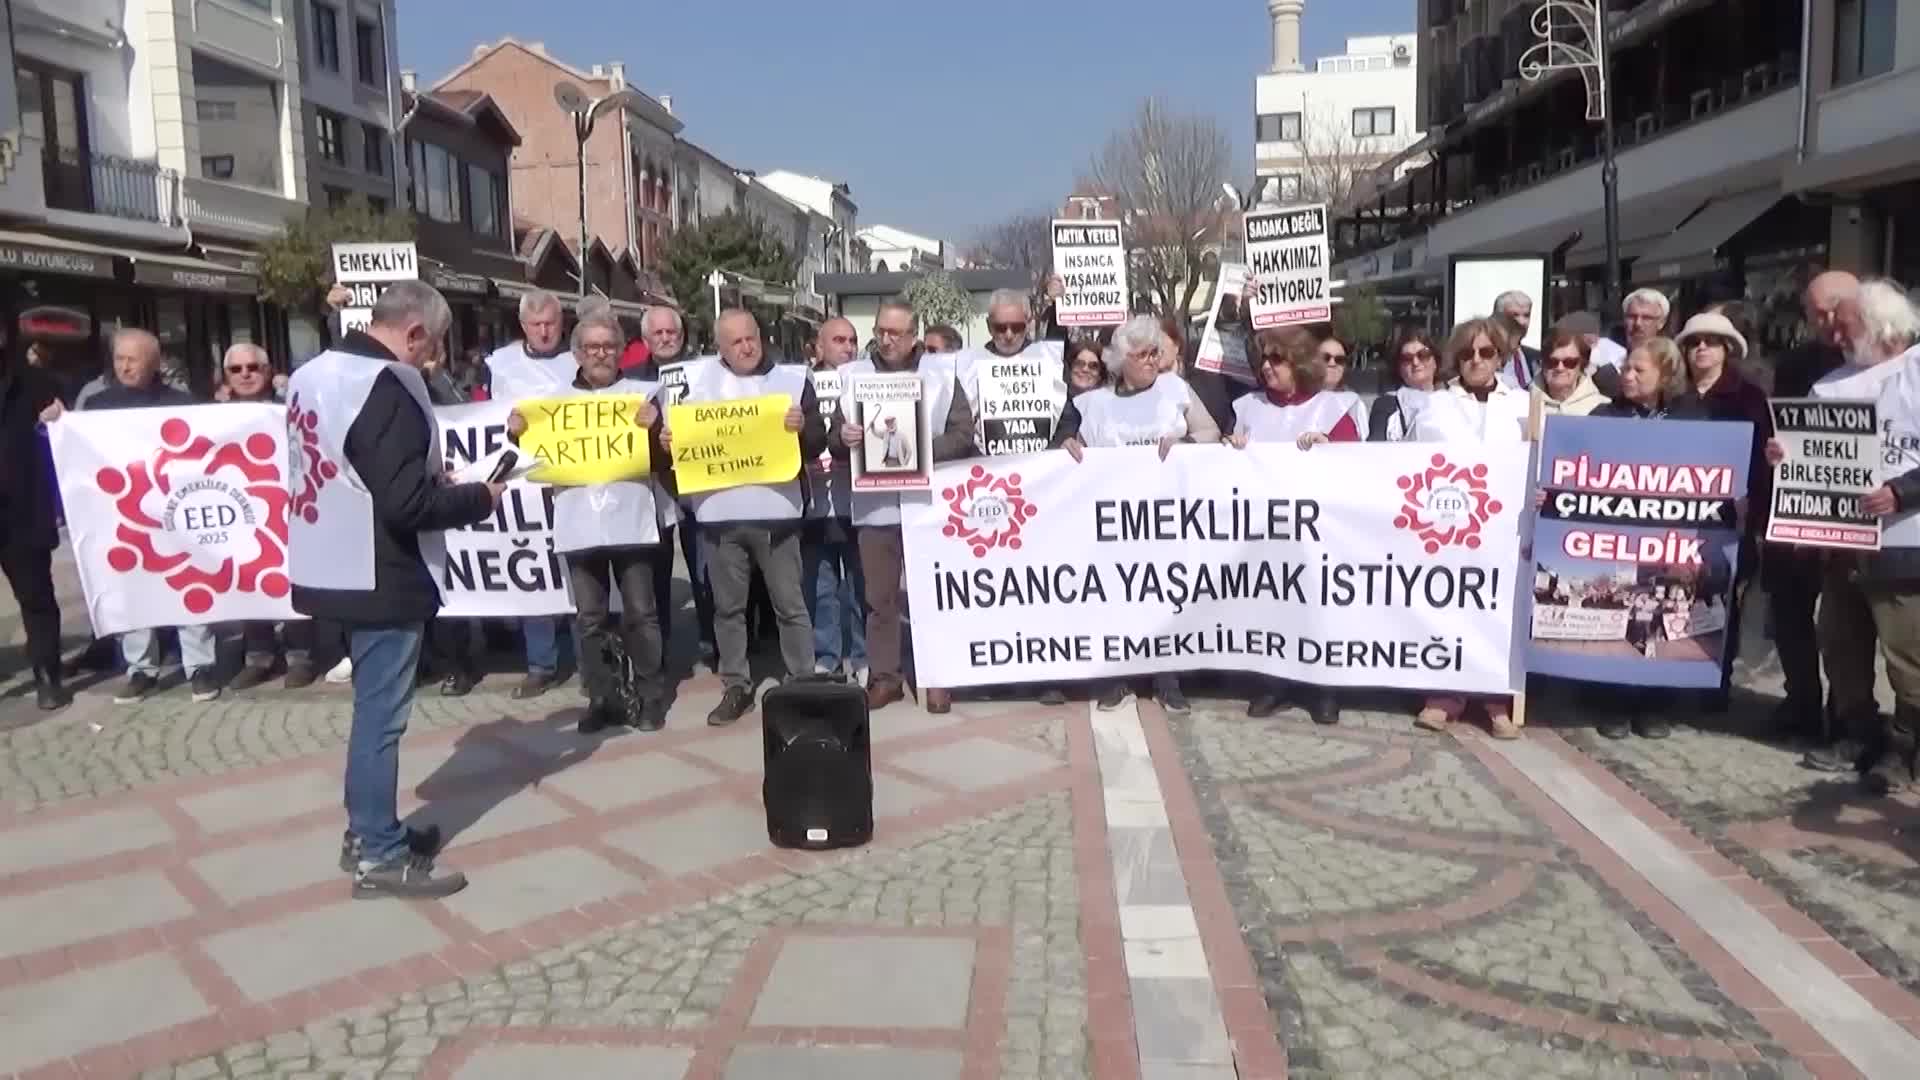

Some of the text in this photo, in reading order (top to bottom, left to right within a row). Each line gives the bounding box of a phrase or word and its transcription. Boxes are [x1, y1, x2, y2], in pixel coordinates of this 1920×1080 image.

[1057, 228, 1117, 243] ARTIK YETER
[1249, 209, 1322, 238] SADAKA DEĞİL
[339, 247, 412, 271] EMEKLİYİ
[1064, 251, 1114, 269] İNSANCA
[1253, 245, 1322, 275] HAKKIMIZI
[1063, 272, 1118, 289] YAŞAMAK
[991, 361, 1042, 378] EMEKLİ
[540, 400, 628, 432] YETER
[695, 404, 759, 422] BAYRAMI
[1002, 399, 1051, 412] ARIYOR
[1779, 407, 1799, 426] 17
[1803, 403, 1871, 429] MİLYON
[1003, 419, 1036, 434] YADA
[534, 431, 633, 465] ARTIK!
[1803, 437, 1858, 460] EMEKLİ
[1553, 455, 1732, 495] PİJAMAYI
[1780, 460, 1873, 489] BİRLEŞEREK
[184, 504, 236, 530] EED
[1095, 487, 1321, 542] EMEKLİLER
[1555, 493, 1724, 521] ÇIKARDIK
[1778, 489, 1832, 517] İKTİDAR
[197, 531, 229, 545] 2025
[1564, 531, 1706, 564] GELDİK
[445, 537, 563, 592] NEĞİ
[934, 553, 1499, 614] İNSANCA YAŞAMAK İSTİYOR!
[969, 623, 1462, 671] EDİRNE EMEKLİLER DERNEĞİ
